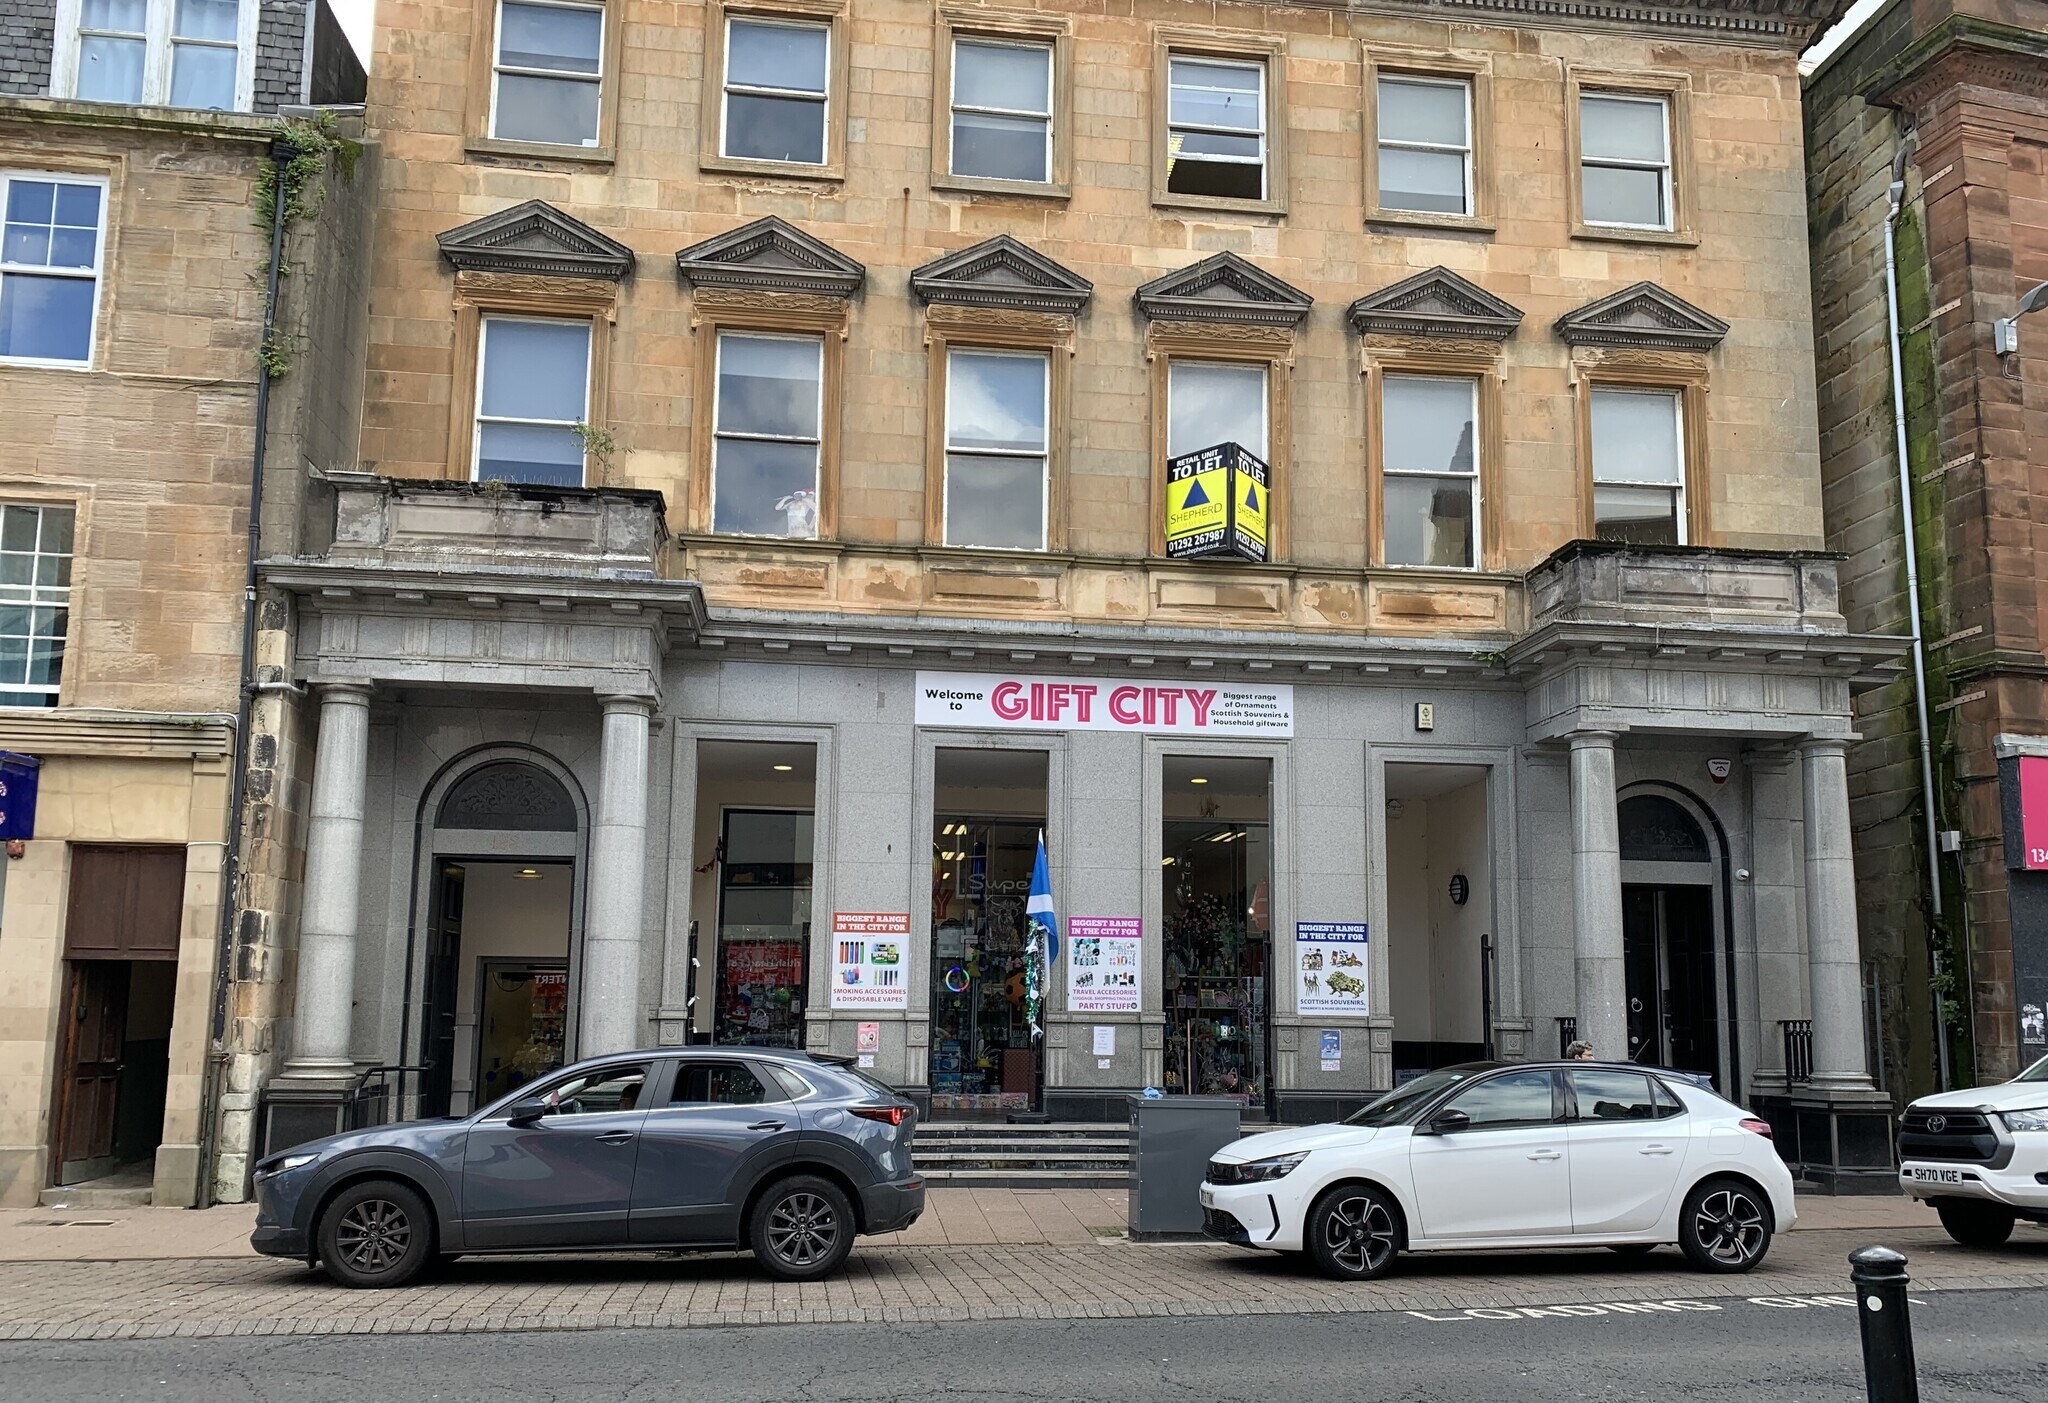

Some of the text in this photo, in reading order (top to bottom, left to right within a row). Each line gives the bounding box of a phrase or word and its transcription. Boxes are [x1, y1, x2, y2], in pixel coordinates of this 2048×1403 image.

[1176, 449, 1219, 467] RETAIL UNIT
[1172, 455, 1223, 481] TO LET
[1237, 455, 1266, 486] TO LET
[1170, 502, 1223, 525] SHEPHERD
[1169, 529, 1225, 552] 01292 267987
[1173, 542, 1220, 558] www.shepherd.co.uk
[925, 689, 984, 701] Welcome
[1223, 692, 1277, 702] Biggest range
[950, 702, 963, 711] to
[991, 681, 1218, 727] GIFT CITY
[1224, 701, 1277, 710] of Ornaments
[1210, 709, 1242, 718] Scottish
[1243, 711, 1282, 719] Souvenirs
[1213, 718, 1289, 729] Household giftware
[836, 915, 907, 923] BIGGEST RANGE
[1109, 920, 1139, 928] RANGE
[867, 923, 888, 931] CITY
[889, 923, 906, 931] FOR
[1121, 928, 1138, 936] FOR
[1298, 924, 1365, 933] BIGGEST RANGE
[1347, 933, 1364, 941] FOR
[1106, 1002, 1131, 1010] STUFF
[1915, 1168, 1958, 1183] SH70 VGE
[1403, 1300, 1724, 1322] LOADING
